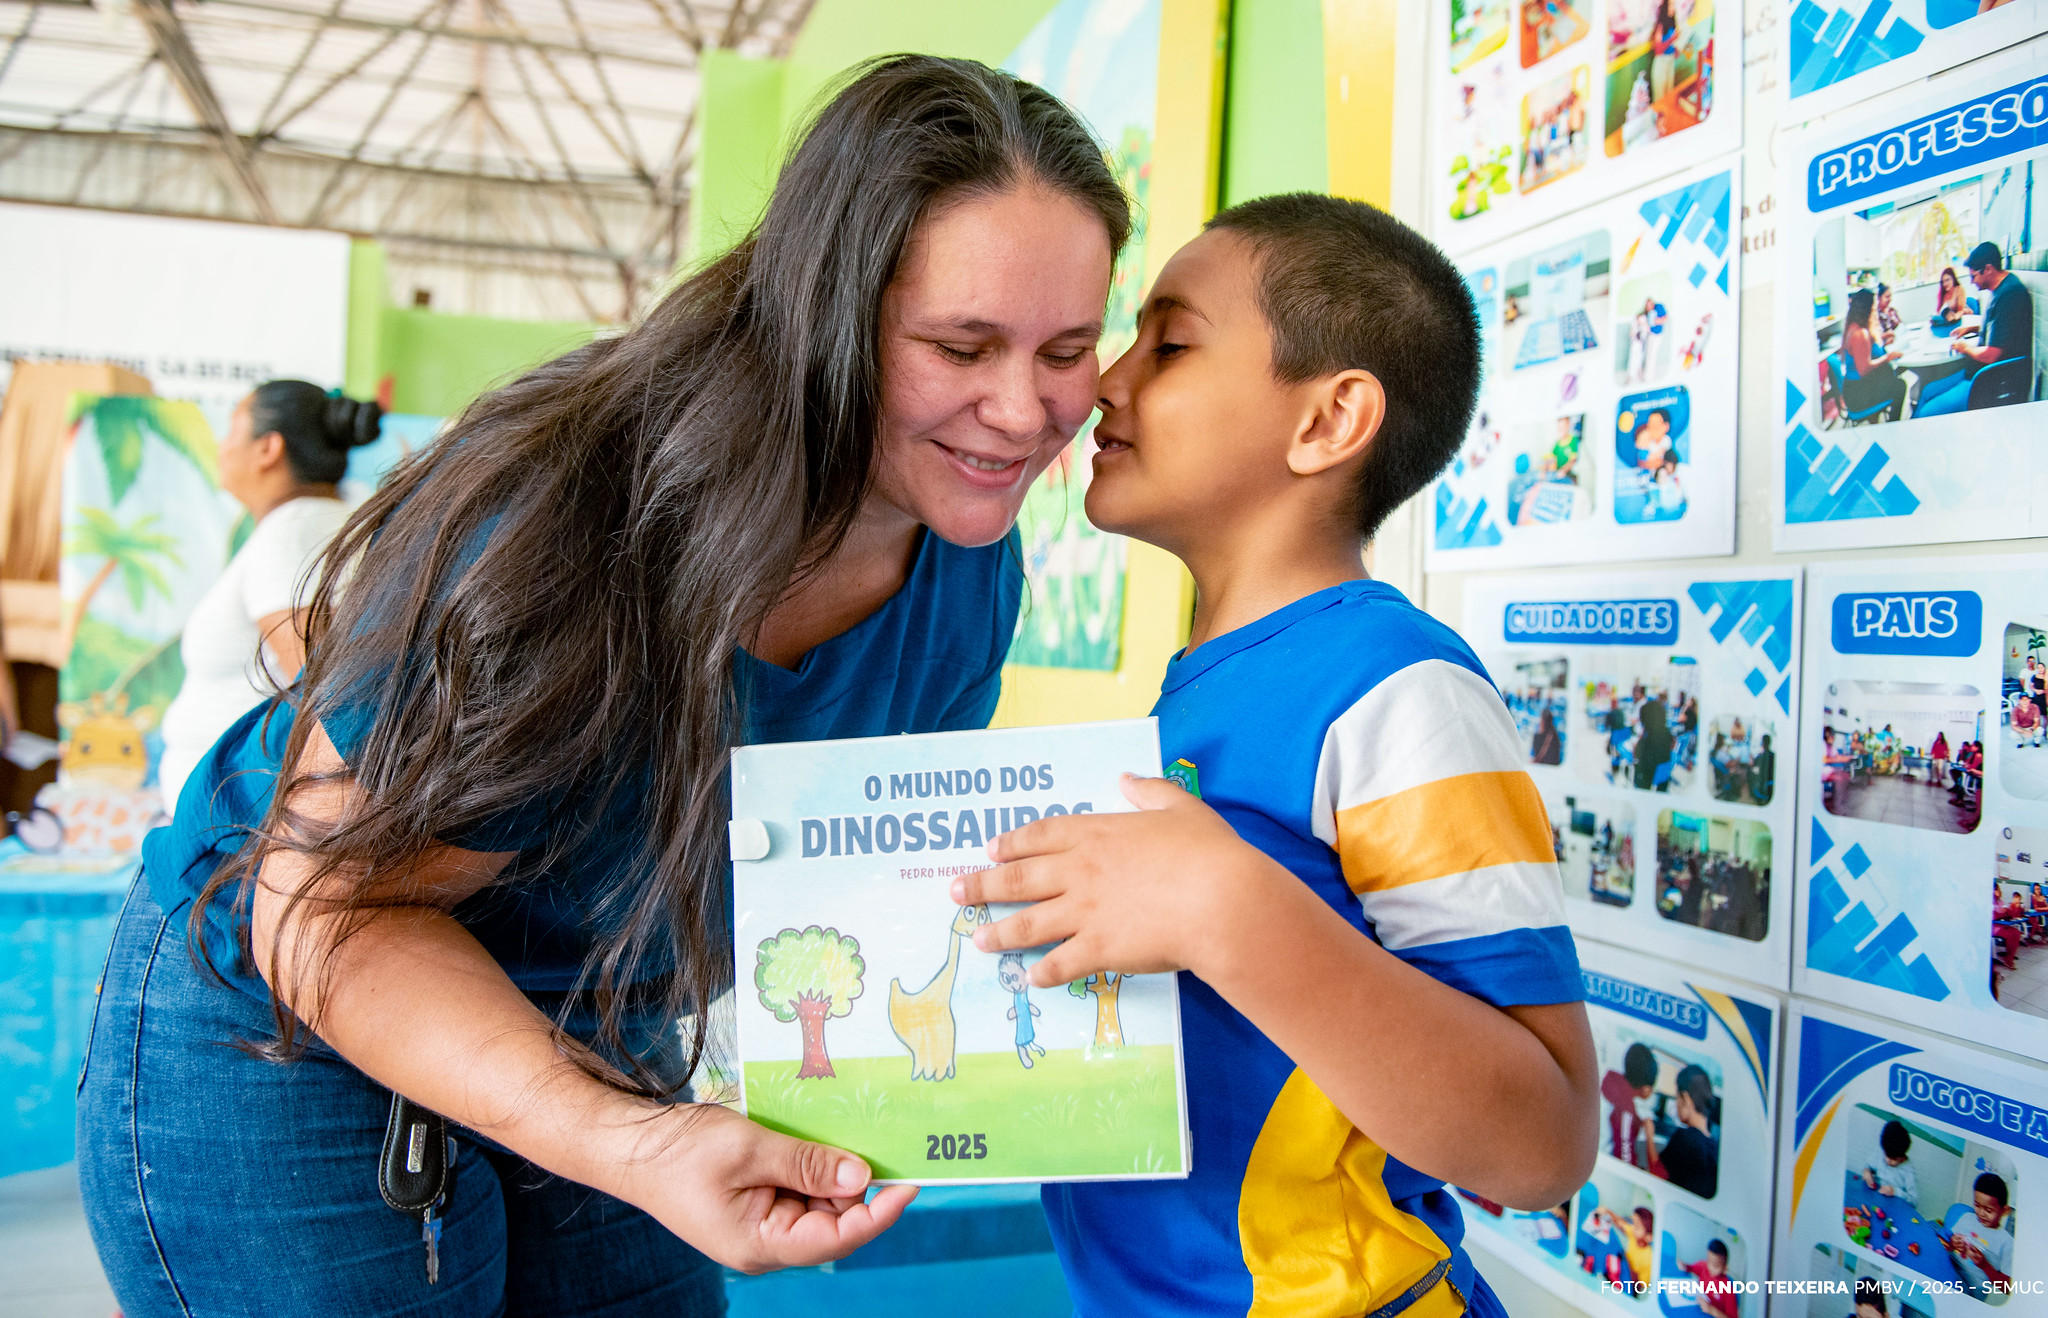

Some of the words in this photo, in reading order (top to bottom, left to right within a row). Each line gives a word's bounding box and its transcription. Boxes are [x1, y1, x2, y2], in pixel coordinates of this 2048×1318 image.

[1818, 82, 2048, 196] PROFESSO
[1507, 602, 1672, 634] CUIDADORES
[1852, 597, 1958, 638] PAIS
[864, 775, 882, 801] O
[890, 768, 992, 800] MUNDO
[1000, 764, 1054, 793] DOS
[801, 802, 1094, 858] DINOSSAU
[900, 868, 934, 880] PEDRO
[1891, 1068, 1995, 1123] JOGOS
[2000, 1101, 2023, 1133] E
[926, 1133, 988, 1160] 2025
